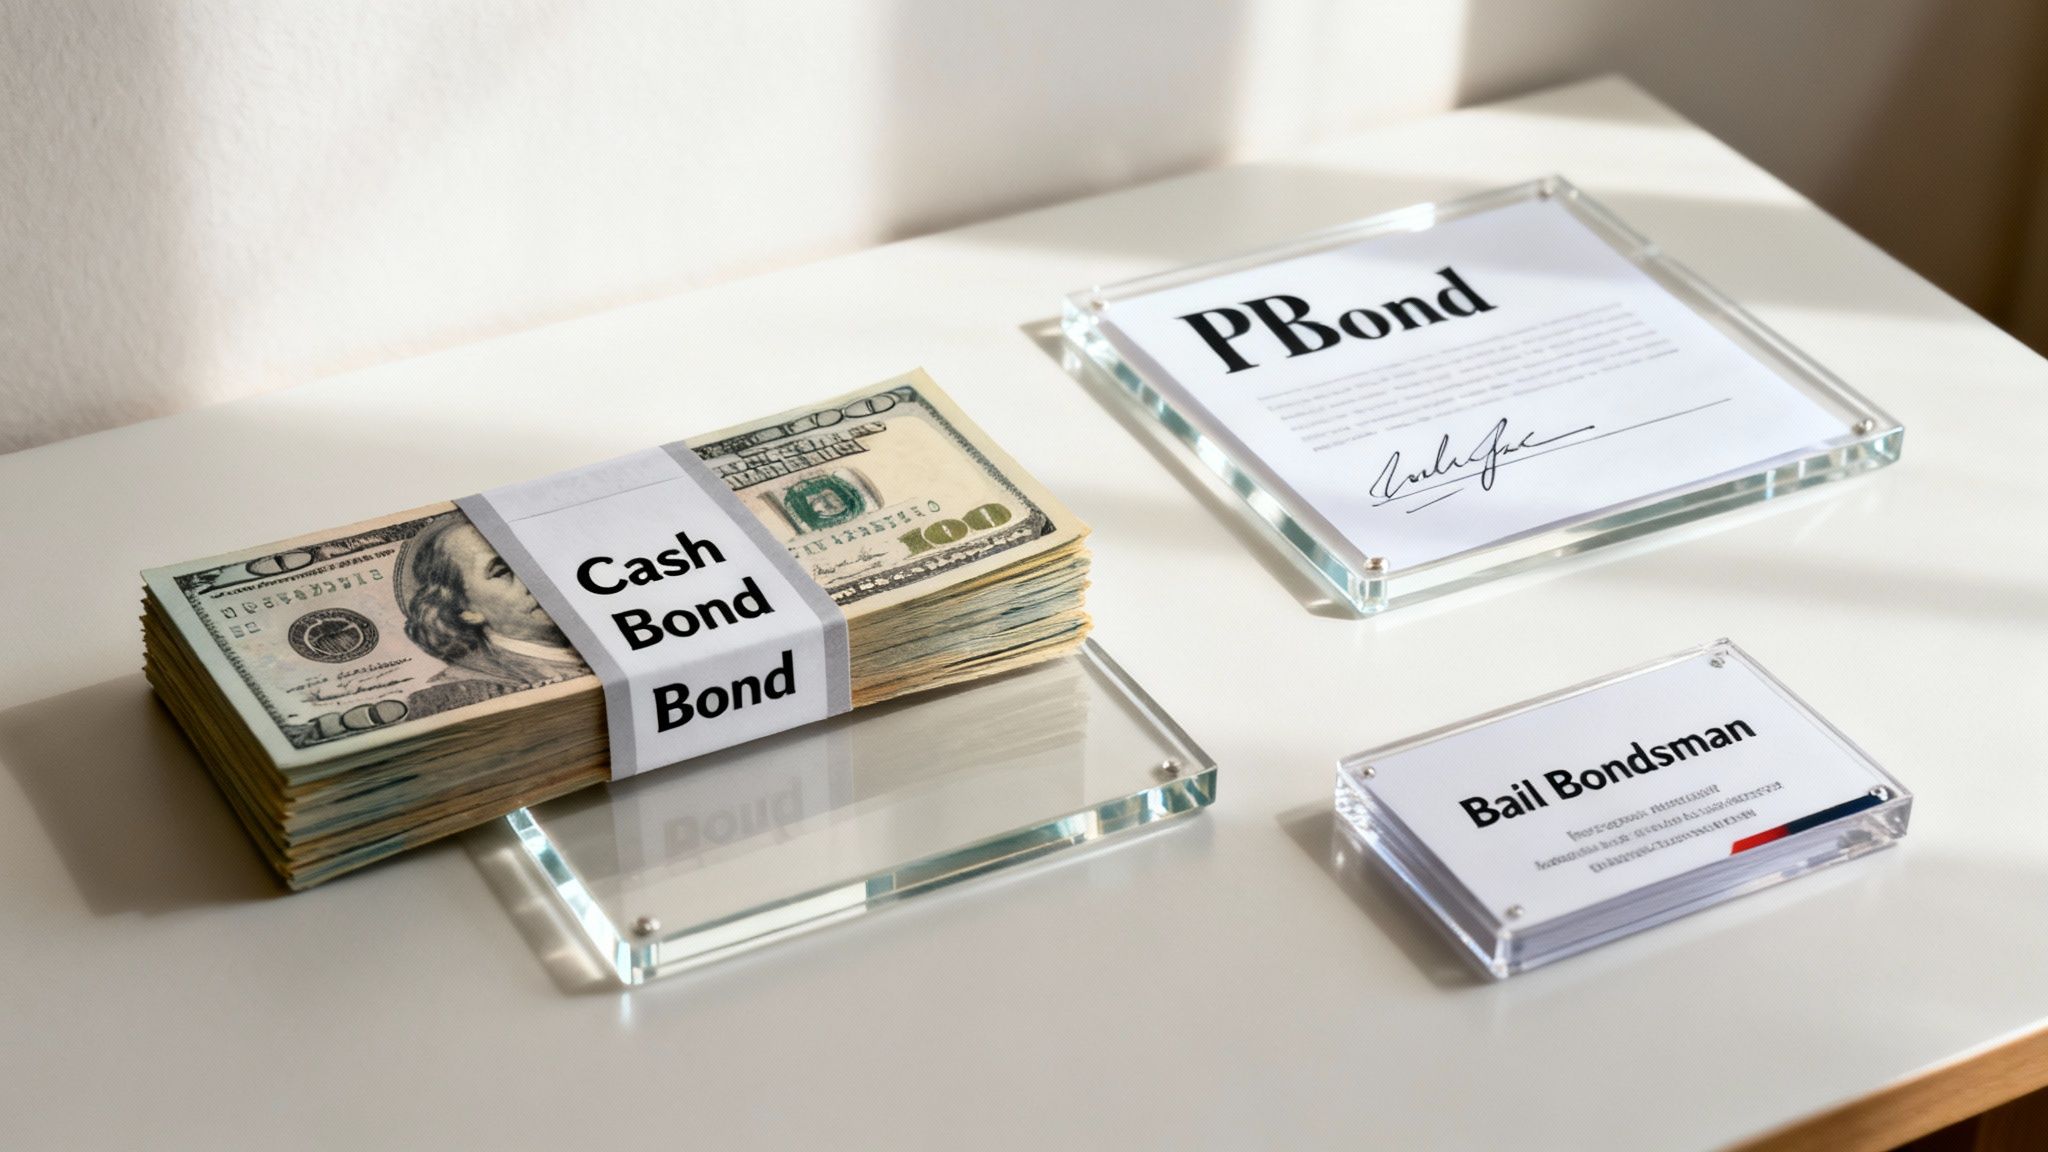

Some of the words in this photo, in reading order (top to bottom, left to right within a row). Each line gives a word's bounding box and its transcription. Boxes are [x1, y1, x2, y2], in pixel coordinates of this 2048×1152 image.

[1180, 266, 1496, 374] PBond
[576, 531, 727, 596] Cash
[898, 502, 1012, 557] 100
[611, 576, 776, 652] Bond
[652, 649, 797, 734] Bond
[1457, 779, 1549, 829] Bail
[1542, 719, 1758, 801] Bondsman
